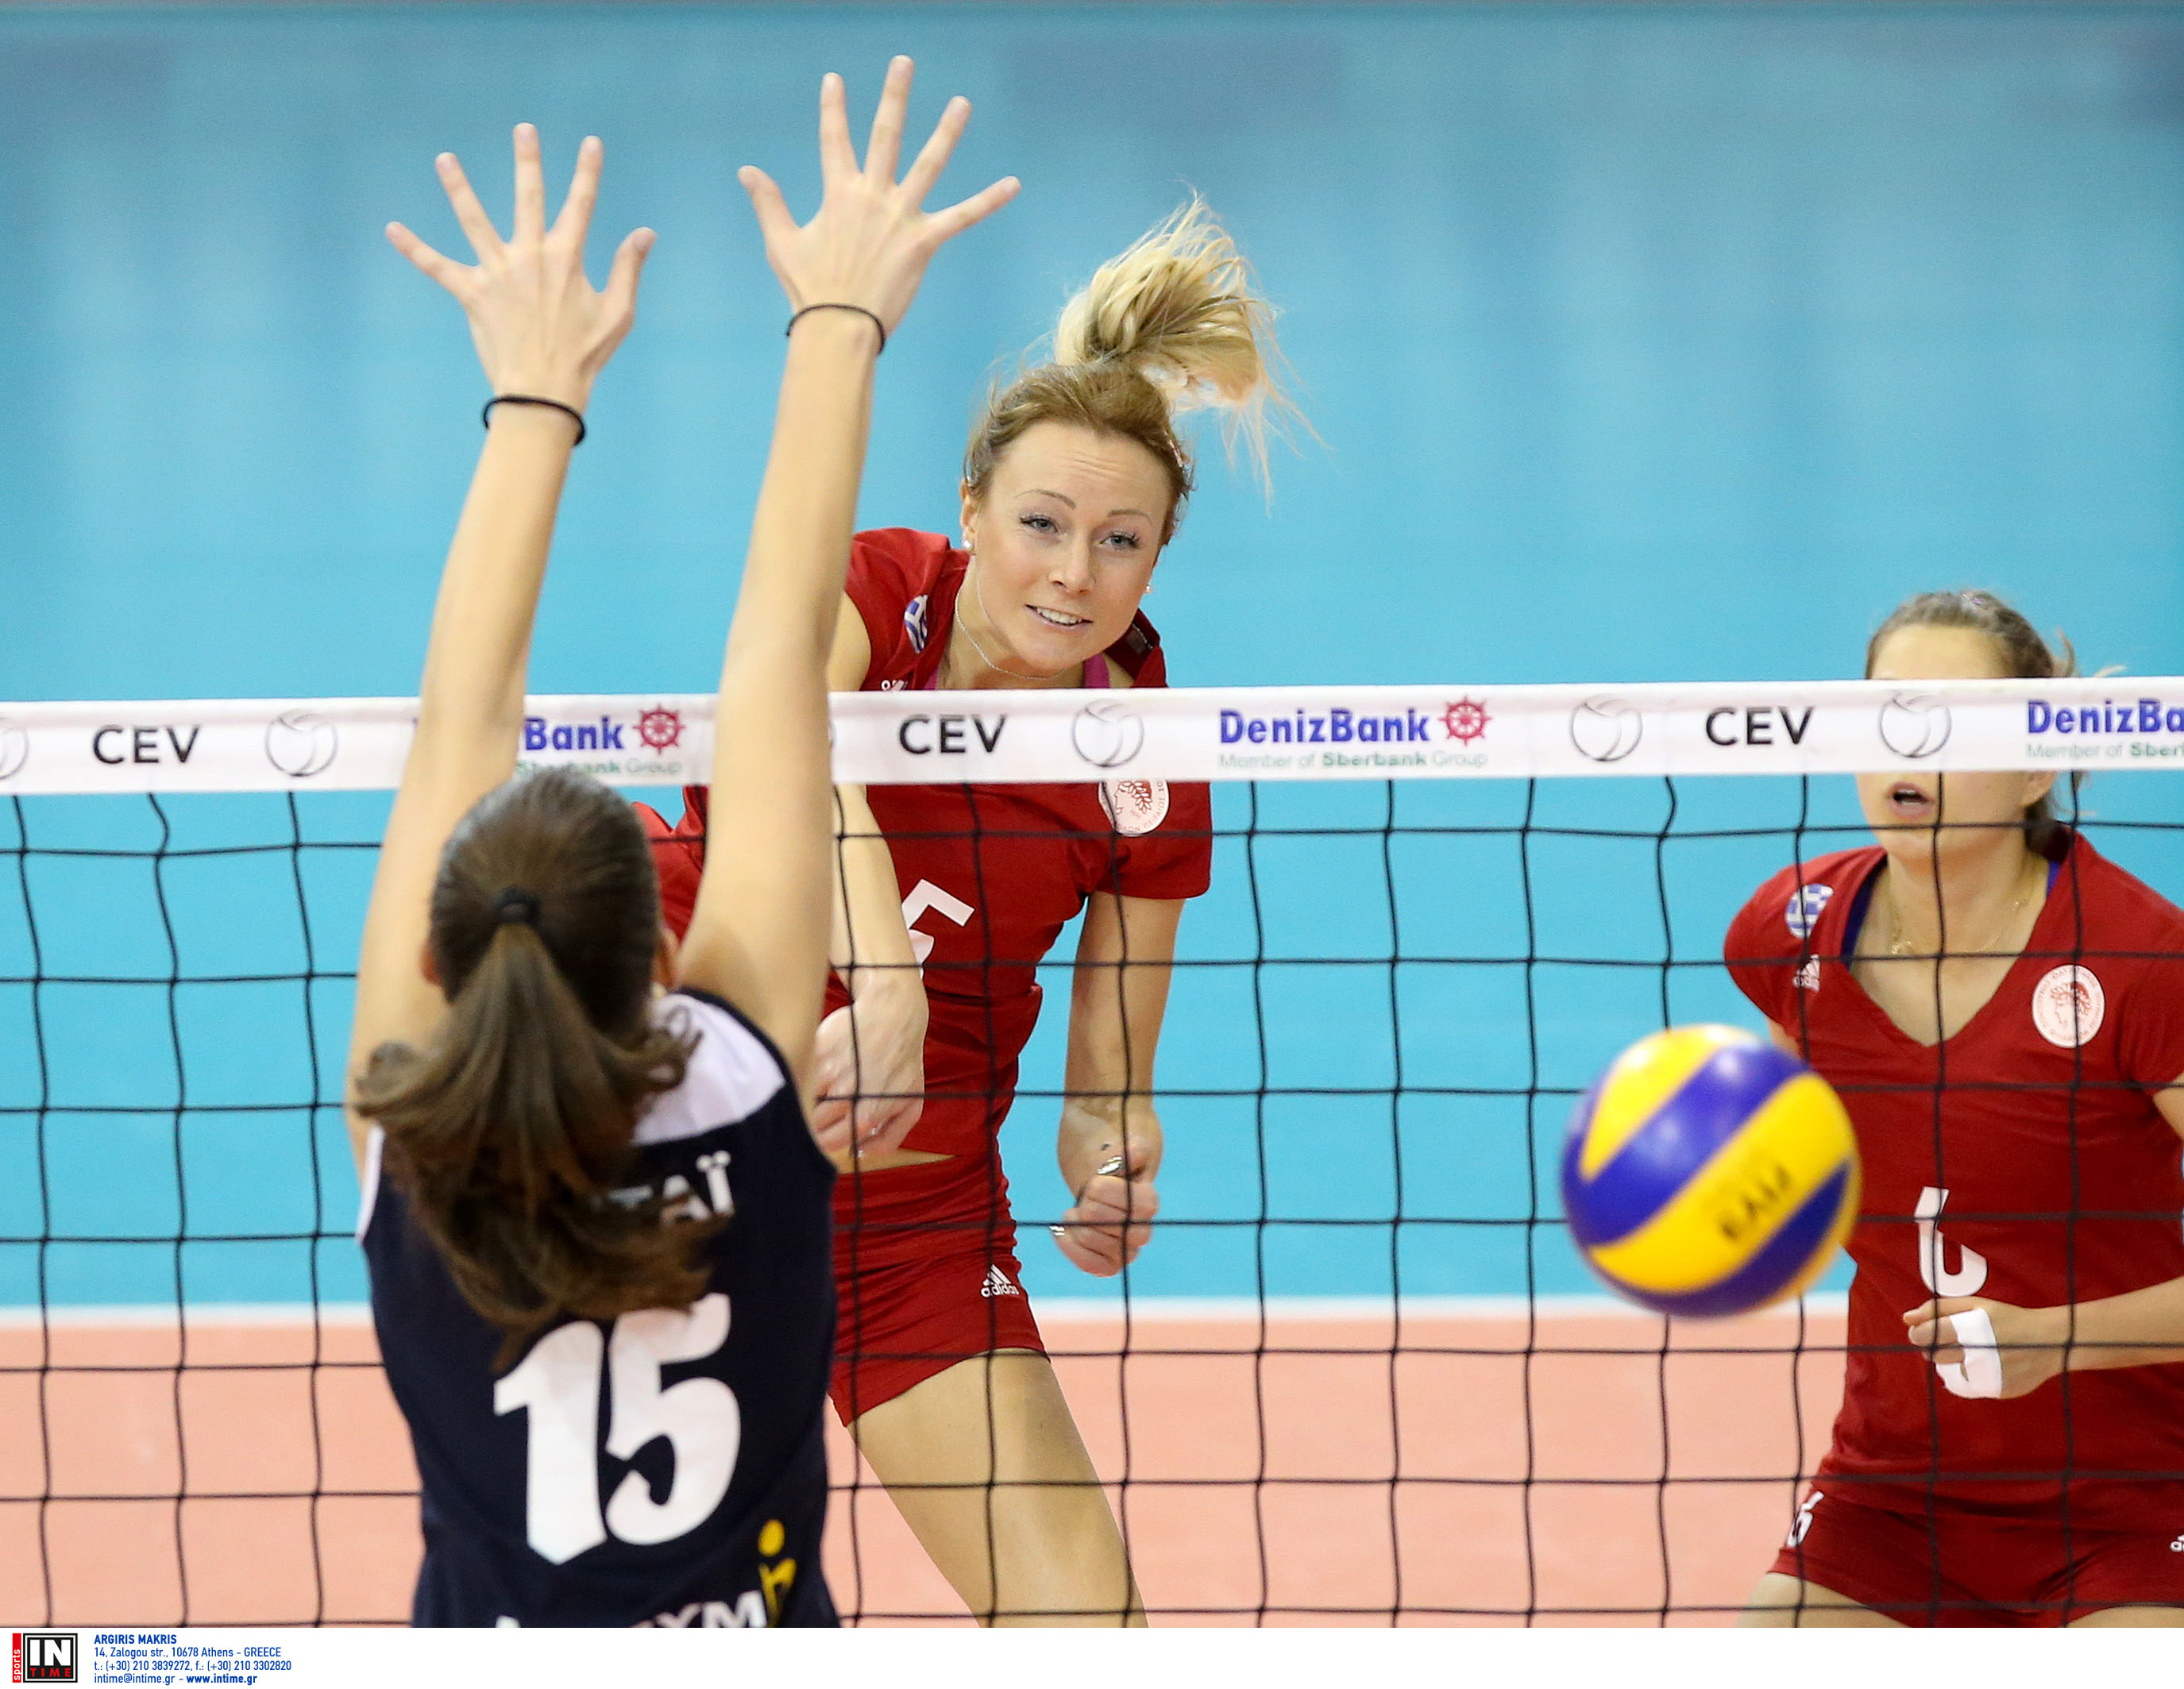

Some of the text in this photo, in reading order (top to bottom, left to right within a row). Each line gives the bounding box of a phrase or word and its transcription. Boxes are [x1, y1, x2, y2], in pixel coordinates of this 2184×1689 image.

[92, 724, 200, 764] CEV
[899, 714, 1008, 754] CEV
[1220, 708, 1430, 743] DenizBank
[1705, 706, 1814, 746] CEV
[1220, 750, 1488, 769] Member of Sberbank Group
[2131, 740, 2184, 758] Sber
[493, 1293, 742, 1565] 15
